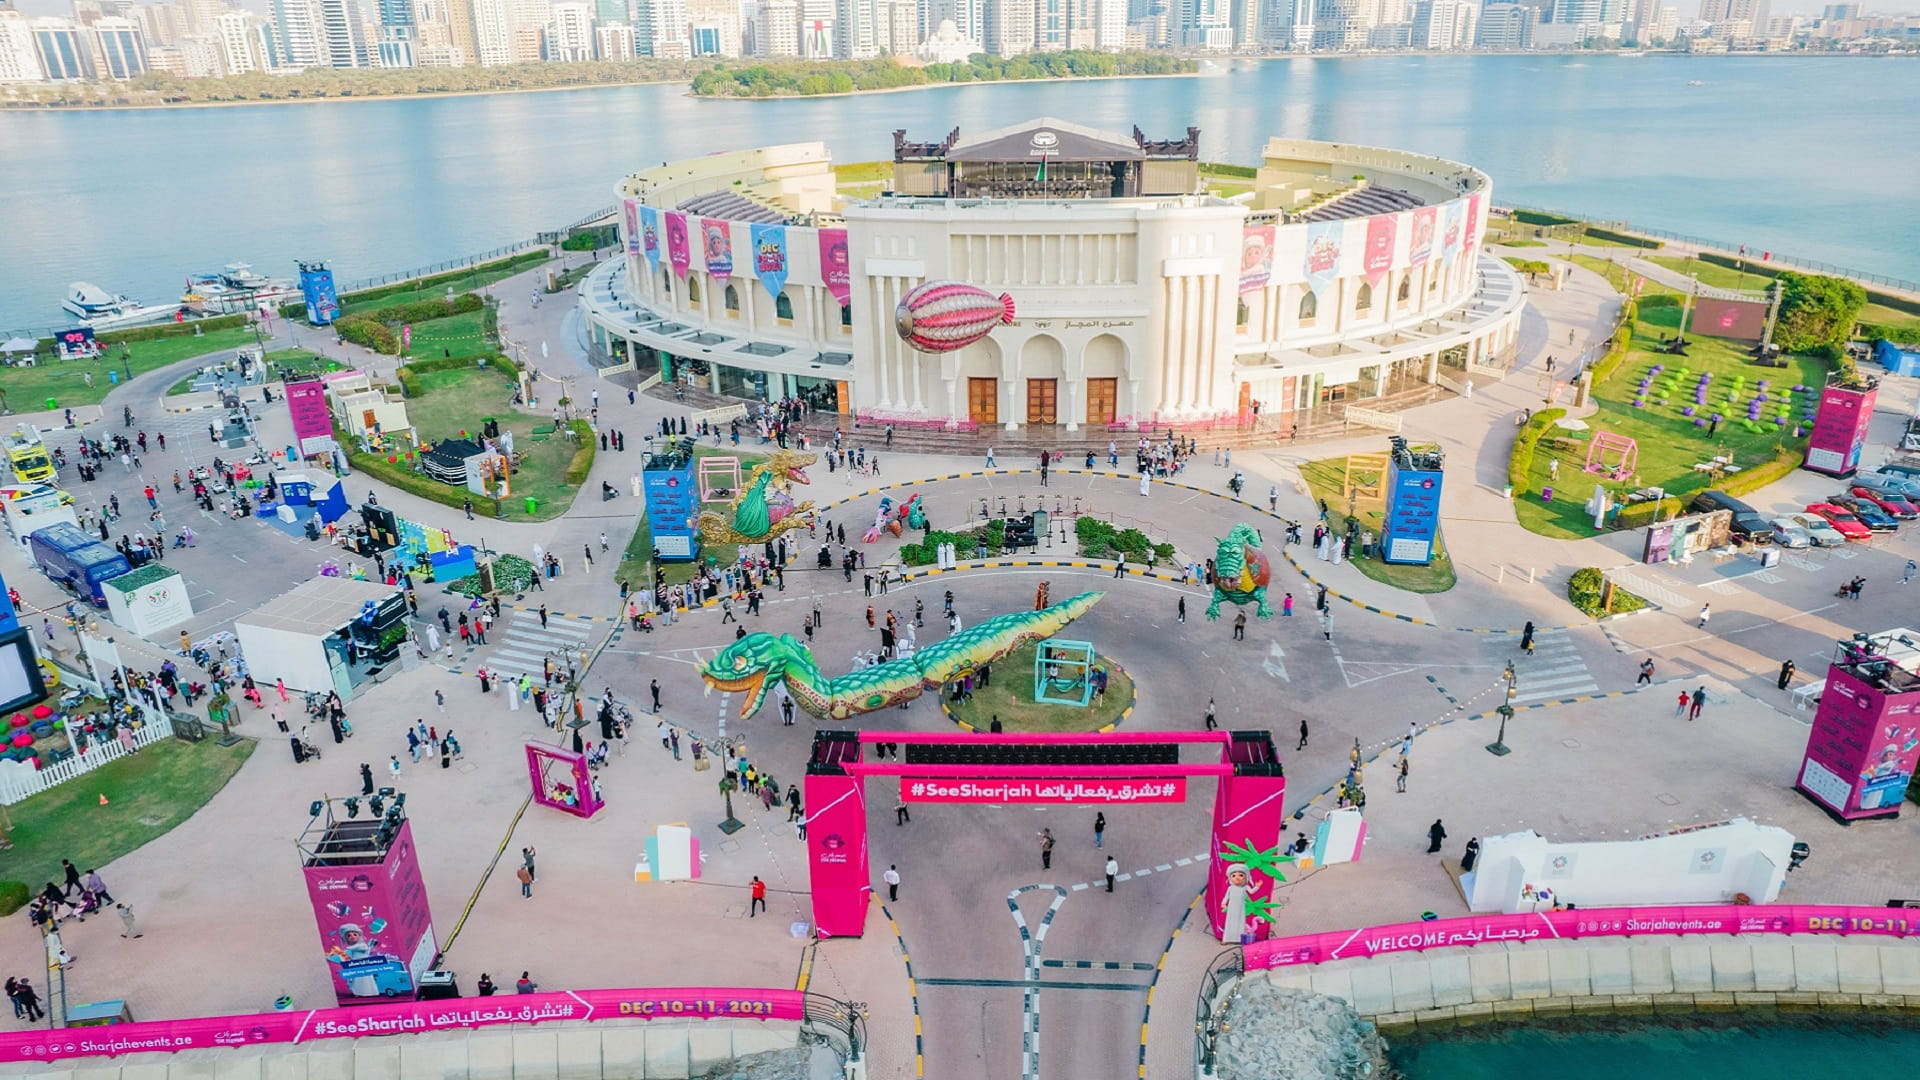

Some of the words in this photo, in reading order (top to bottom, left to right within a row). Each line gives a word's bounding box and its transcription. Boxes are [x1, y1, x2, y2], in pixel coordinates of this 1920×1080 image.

[761, 244, 779, 253] DEC
[1064, 320, 1099, 330] المجاز
[65, 332, 85, 343] 95
[911, 783, 1032, 801] #SeeSharjah
[1626, 917, 1722, 932] Sharjahevents.ae
[1808, 917, 1844, 931] DEC
[1365, 931, 1446, 953] WELCOME
[619, 1001, 655, 1014] DEC
[729, 1000, 774, 1014] 2021
[314, 1014, 426, 1035] #SeeSharjah
[80, 1035, 193, 1053] Sharjahevents.ae
